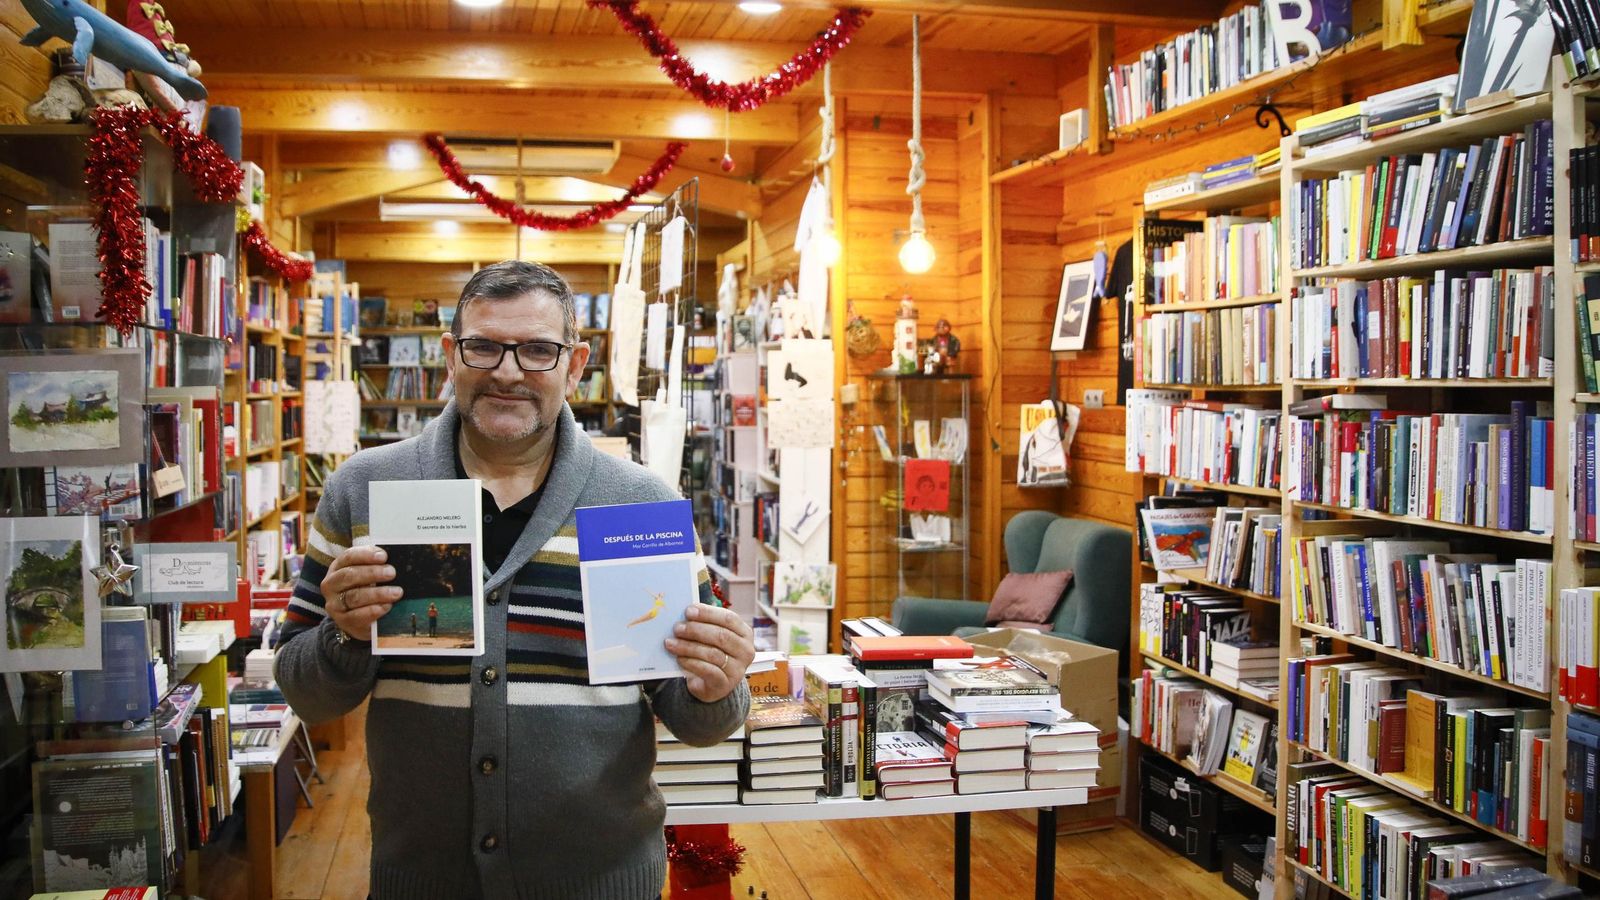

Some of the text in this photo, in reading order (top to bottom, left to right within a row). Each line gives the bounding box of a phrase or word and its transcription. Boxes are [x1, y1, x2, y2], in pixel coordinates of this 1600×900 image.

[1266, 0, 1322, 66] B
[1586, 435, 1594, 447] EL
[1586, 450, 1594, 479] MIEDO
[603, 533, 634, 543] DESPUÉS
[655, 531, 683, 539] PISCINA
[1213, 613, 1252, 642] JAZZ
[763, 681, 778, 692] de
[1287, 784, 1296, 831] DINERO
